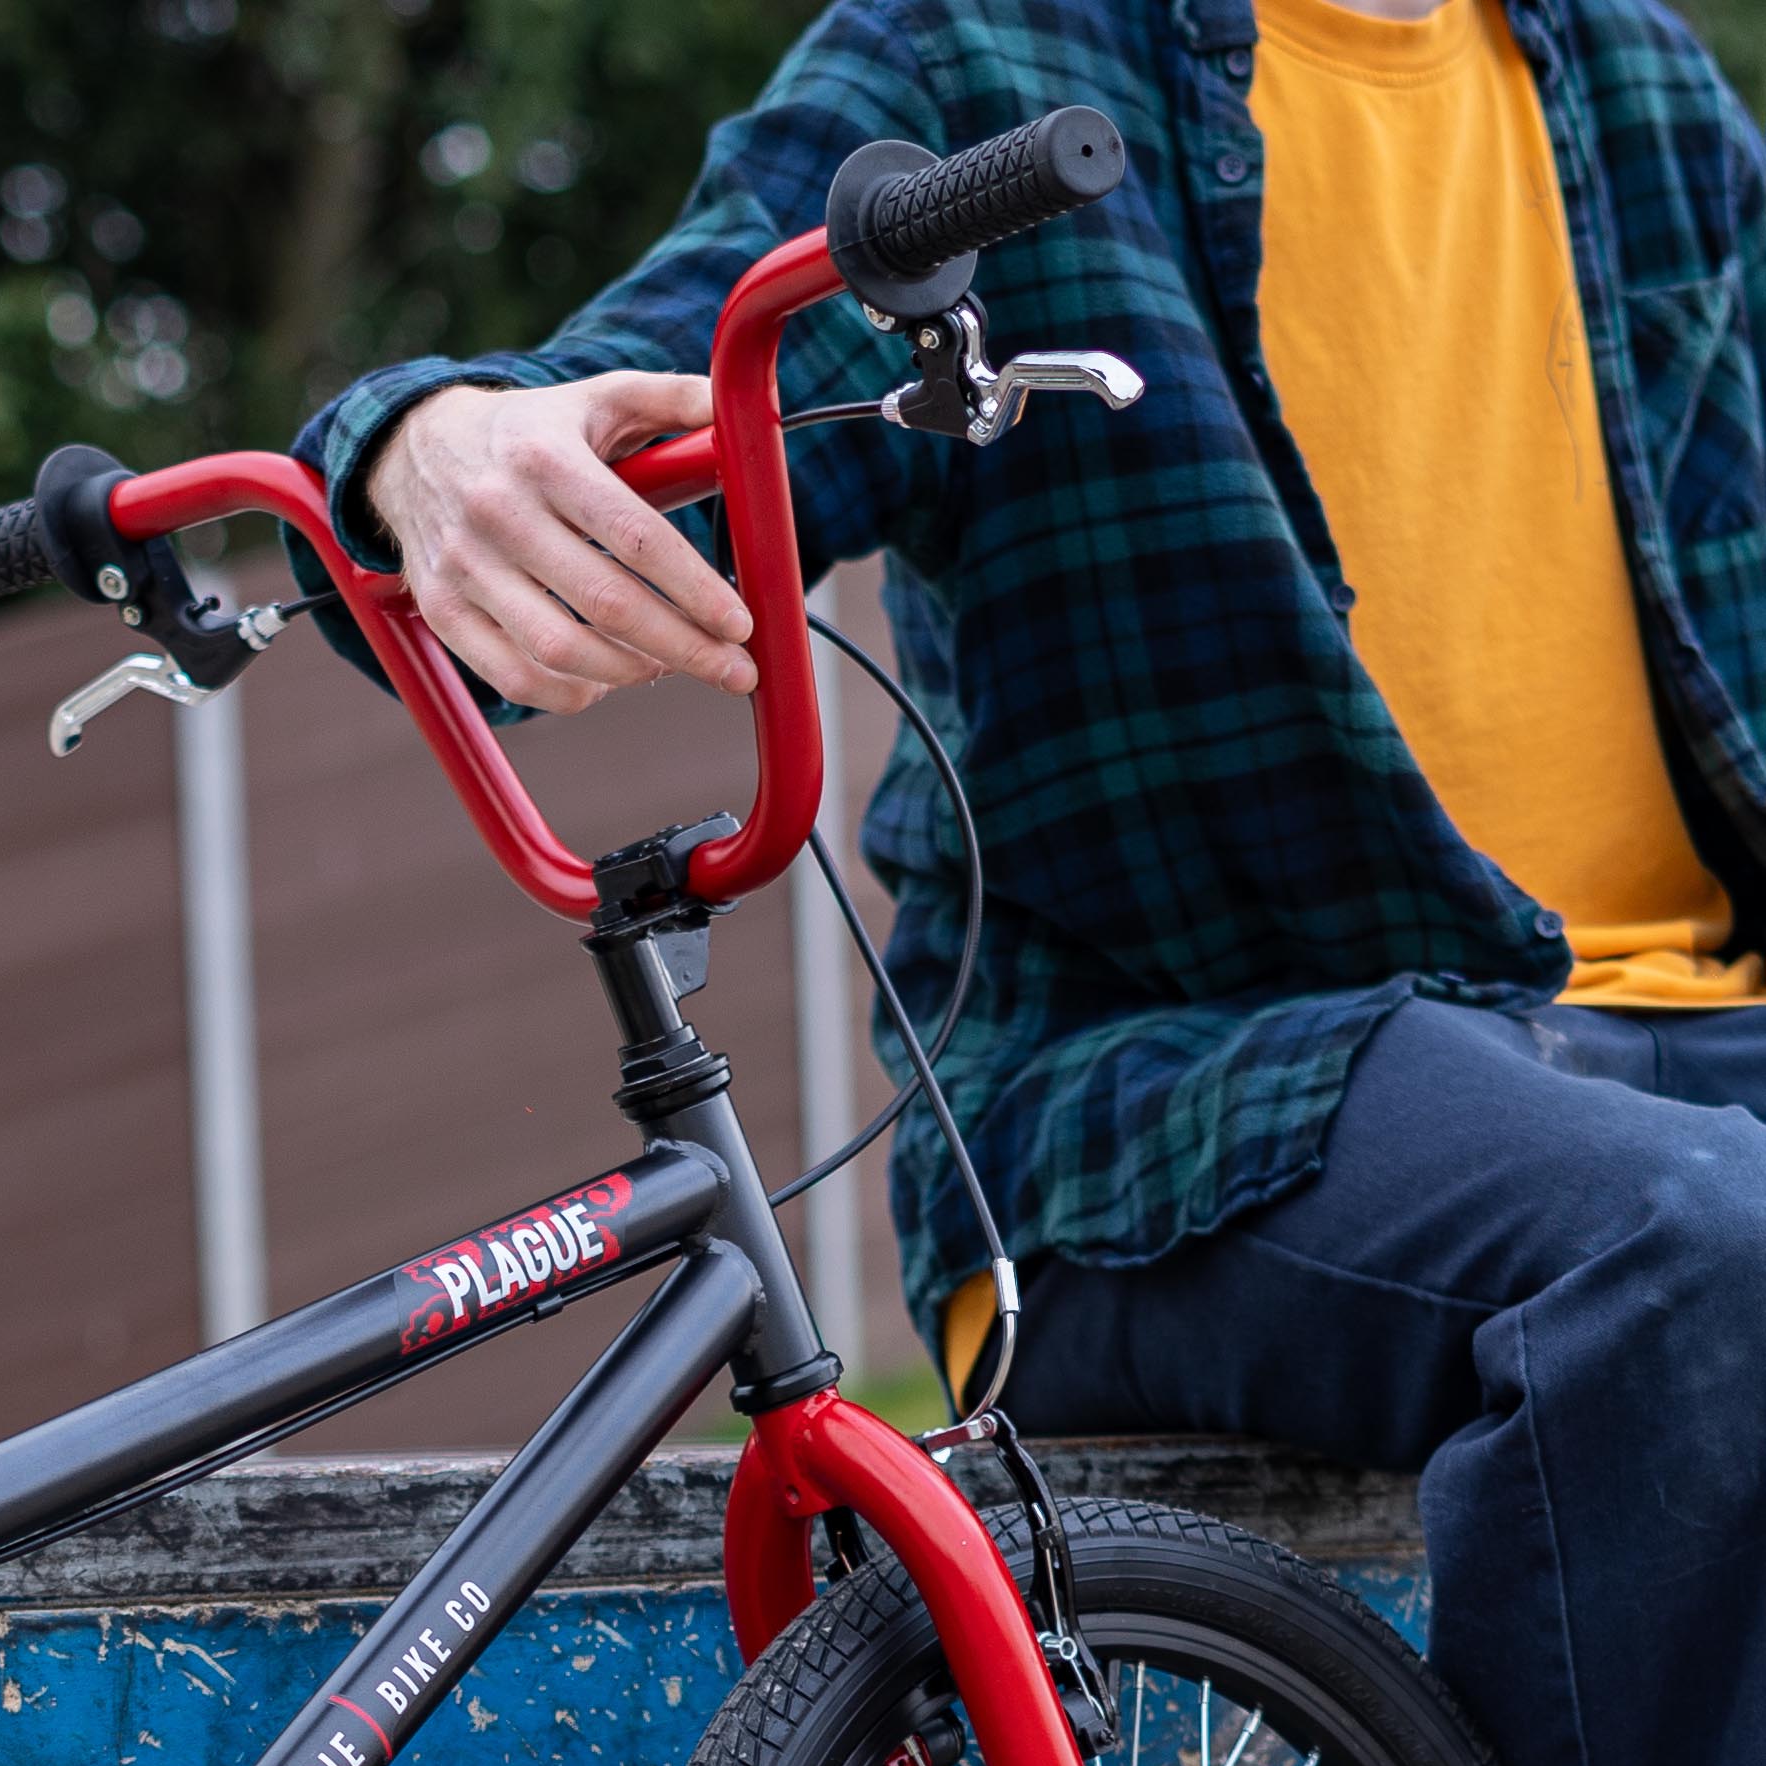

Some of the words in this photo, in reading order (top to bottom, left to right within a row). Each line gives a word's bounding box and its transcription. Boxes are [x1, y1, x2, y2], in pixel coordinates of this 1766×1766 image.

[432, 1203, 606, 1319] PLAGUE
[375, 1627, 453, 1717] BIKE
[448, 1580, 493, 1634] CO
